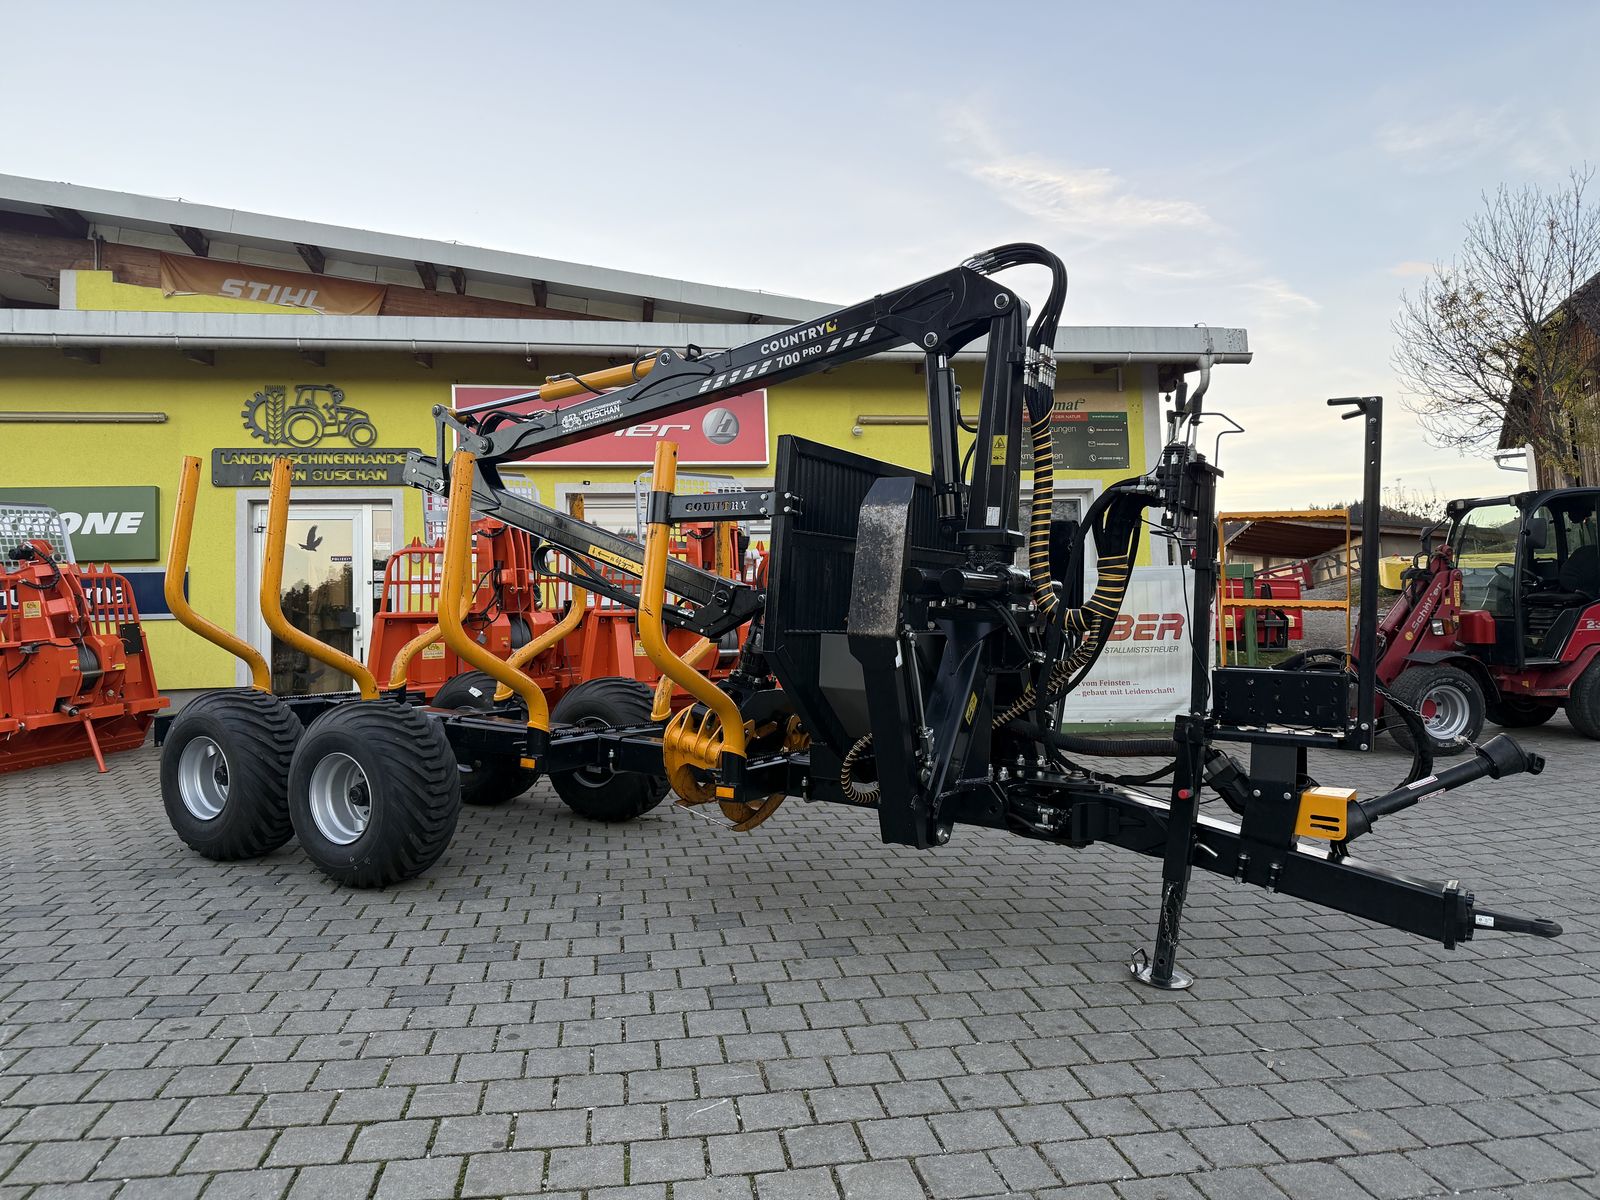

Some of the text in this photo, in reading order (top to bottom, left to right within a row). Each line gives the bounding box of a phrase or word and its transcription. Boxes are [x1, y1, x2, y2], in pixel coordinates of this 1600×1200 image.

[218, 278, 325, 309] STIHL
[760, 323, 826, 355] COUNTRY
[776, 344, 822, 368] 700 PRO
[221, 453, 407, 465] LANDMSCHINENHANDE
[252, 470, 388, 481] ANN OUSCHAN
[685, 500, 748, 513] COUNTRY
[1106, 613, 1185, 641] BER
[1104, 646, 1179, 654] STALLMISTSTREUER
[1099, 679, 1131, 687] Feinsten
[1082, 689, 1108, 697] gebaut
[1109, 688, 1124, 696] mit
[1125, 687, 1175, 695] Leidenschaft!
